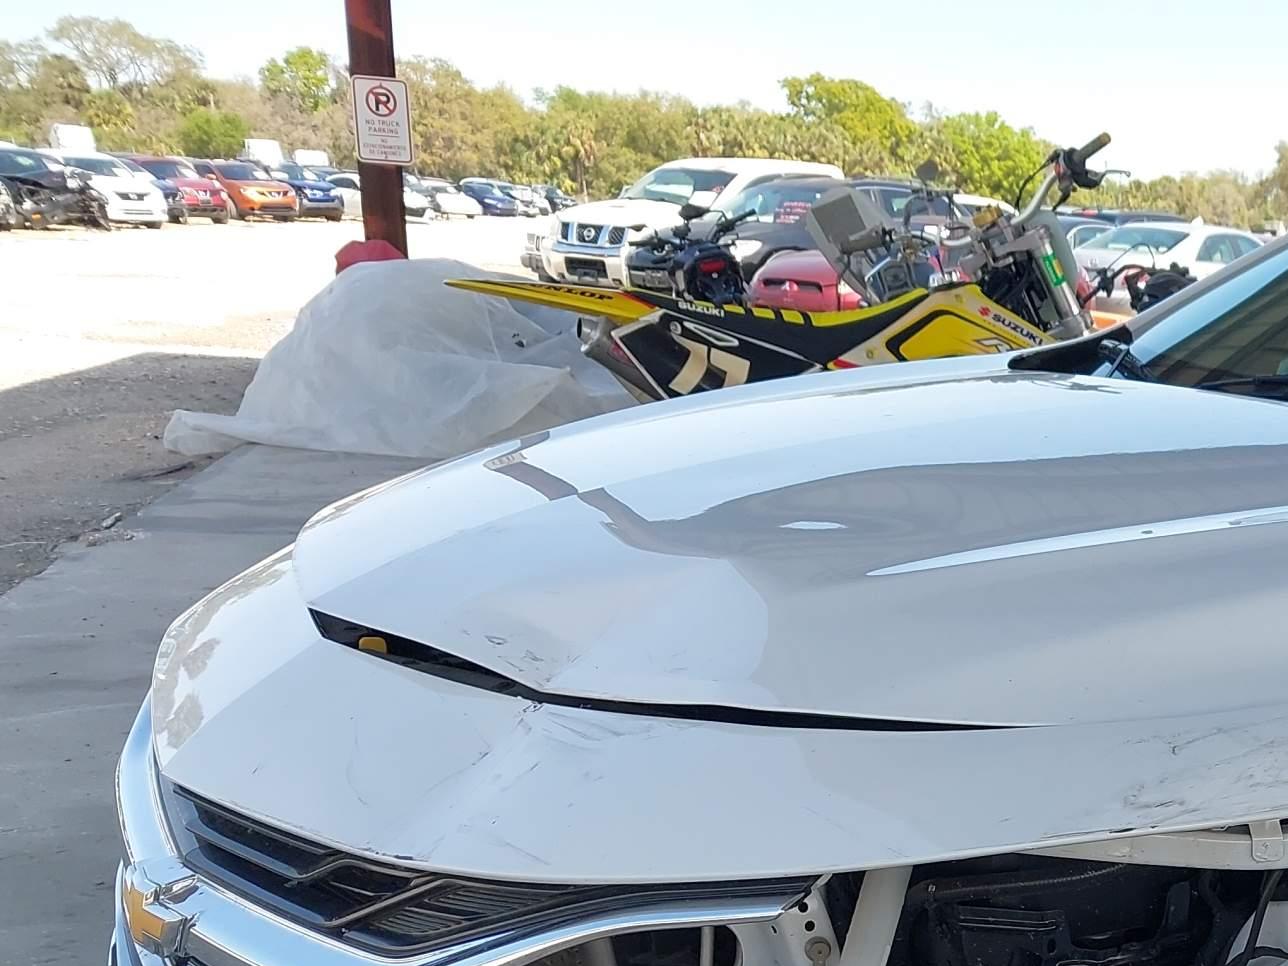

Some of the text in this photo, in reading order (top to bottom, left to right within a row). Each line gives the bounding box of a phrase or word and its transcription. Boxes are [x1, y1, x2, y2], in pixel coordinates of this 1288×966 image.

[378, 119, 400, 127] TRUCK
[368, 126, 398, 134] PARKING
[678, 301, 725, 318] SUZUKI
[991, 313, 1043, 346] SUZUKI
